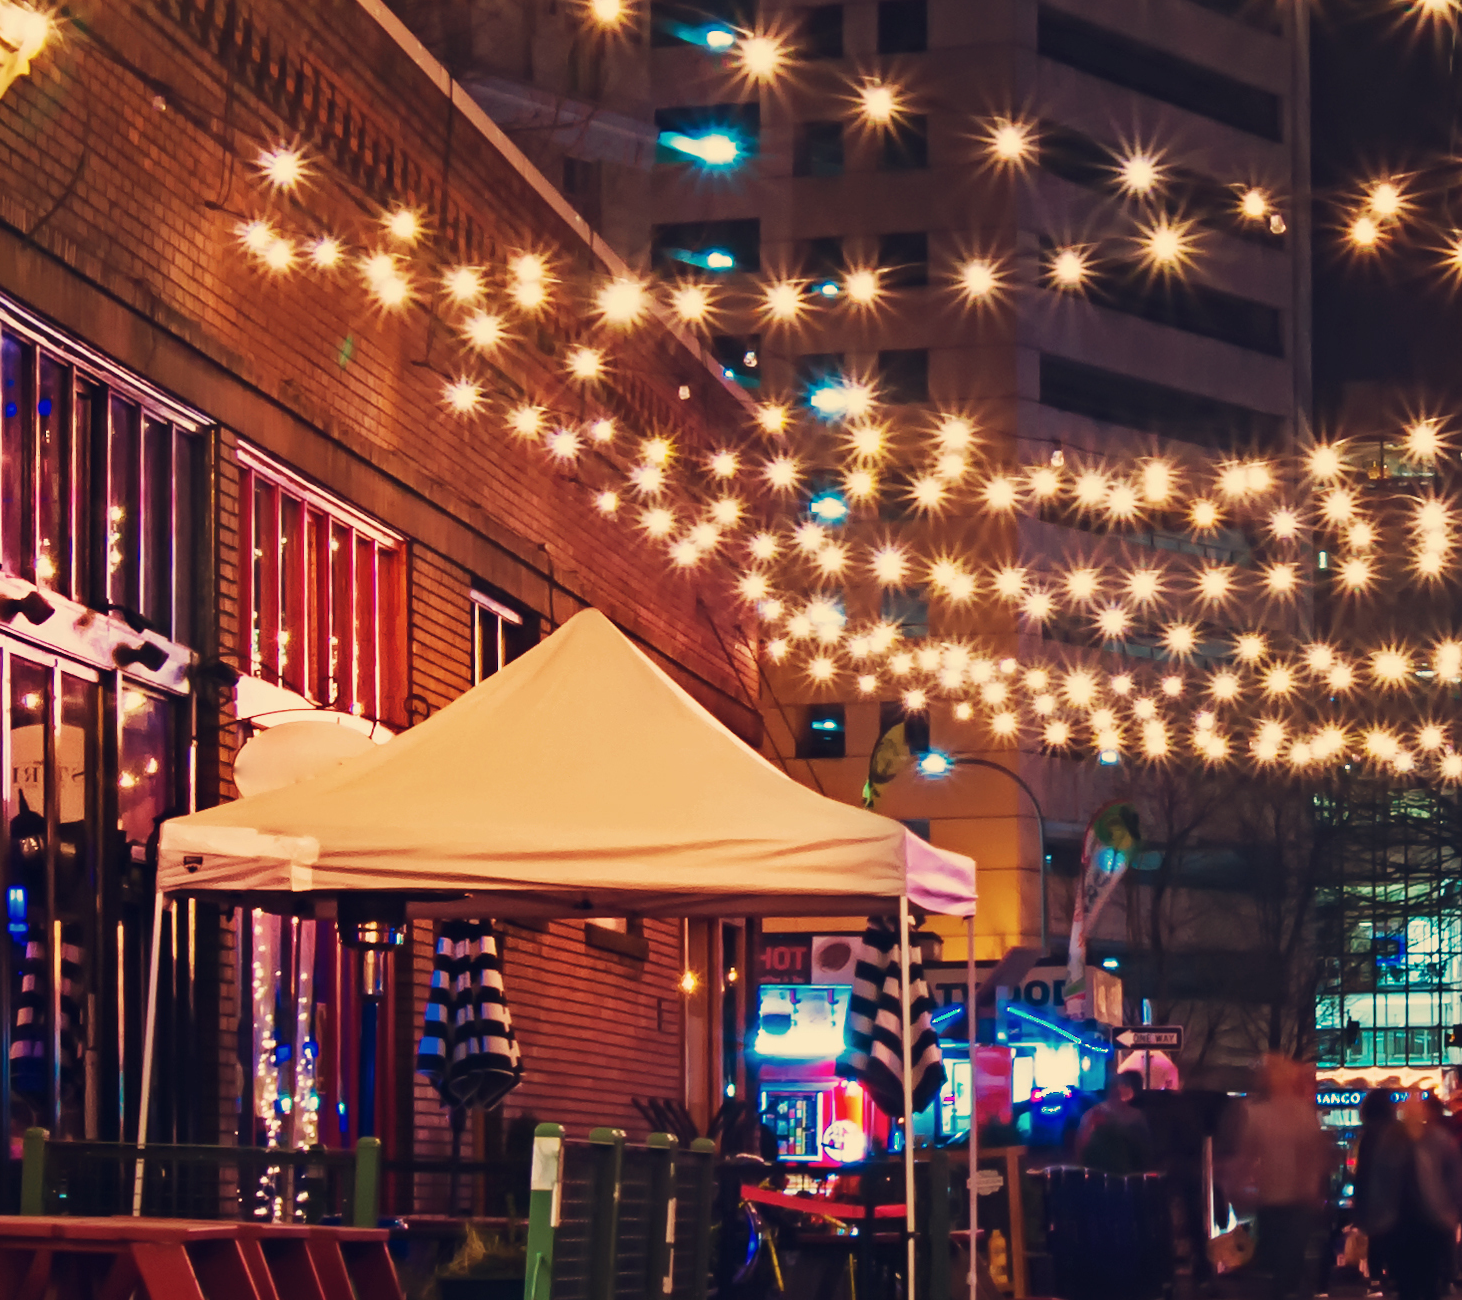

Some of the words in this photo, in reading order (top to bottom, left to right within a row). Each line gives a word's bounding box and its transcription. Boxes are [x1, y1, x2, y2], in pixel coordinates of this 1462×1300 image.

[760, 946, 807, 971] HOT
[1134, 1032, 1151, 1044] ONE
[1155, 1032, 1176, 1044] WAY
